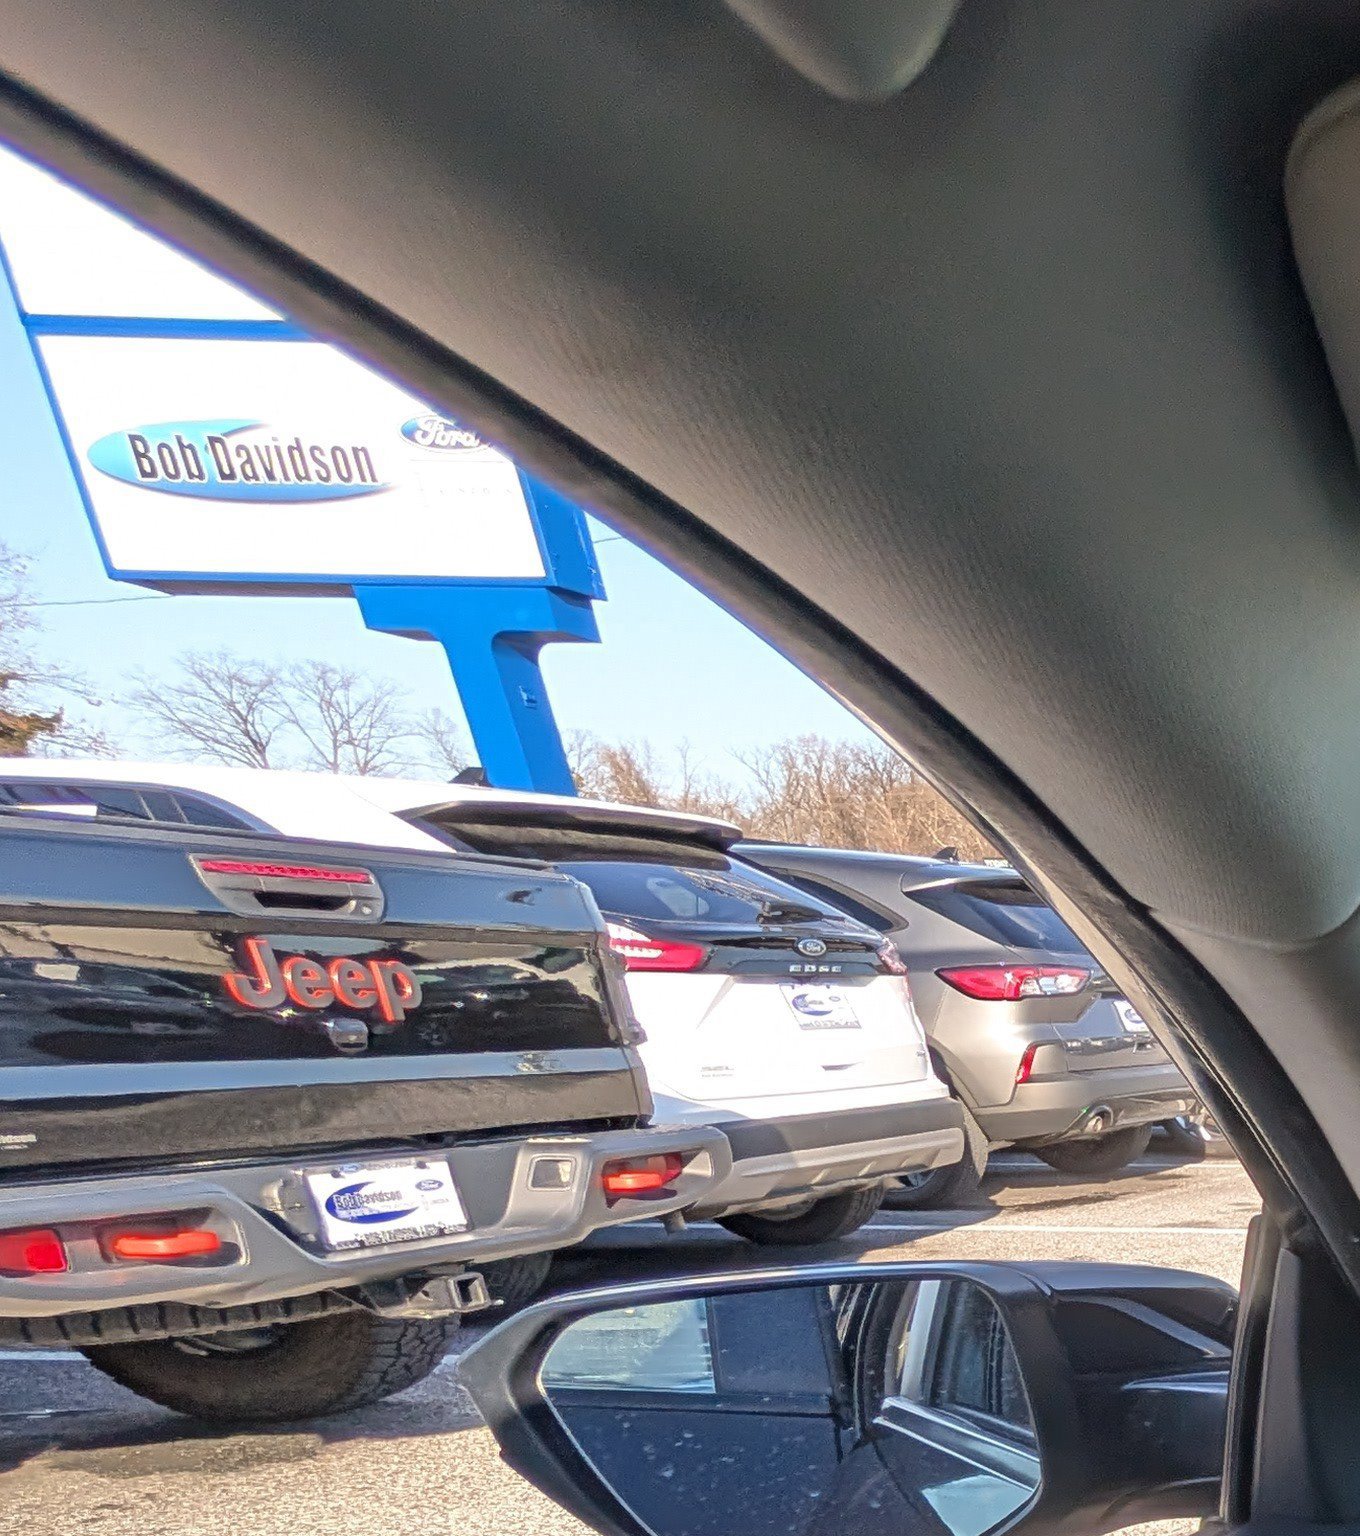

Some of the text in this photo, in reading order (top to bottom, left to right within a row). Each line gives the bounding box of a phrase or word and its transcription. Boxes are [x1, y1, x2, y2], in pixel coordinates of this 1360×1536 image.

[128, 433, 379, 484] Bob Davidson
[221, 936, 423, 1023] Jeep
